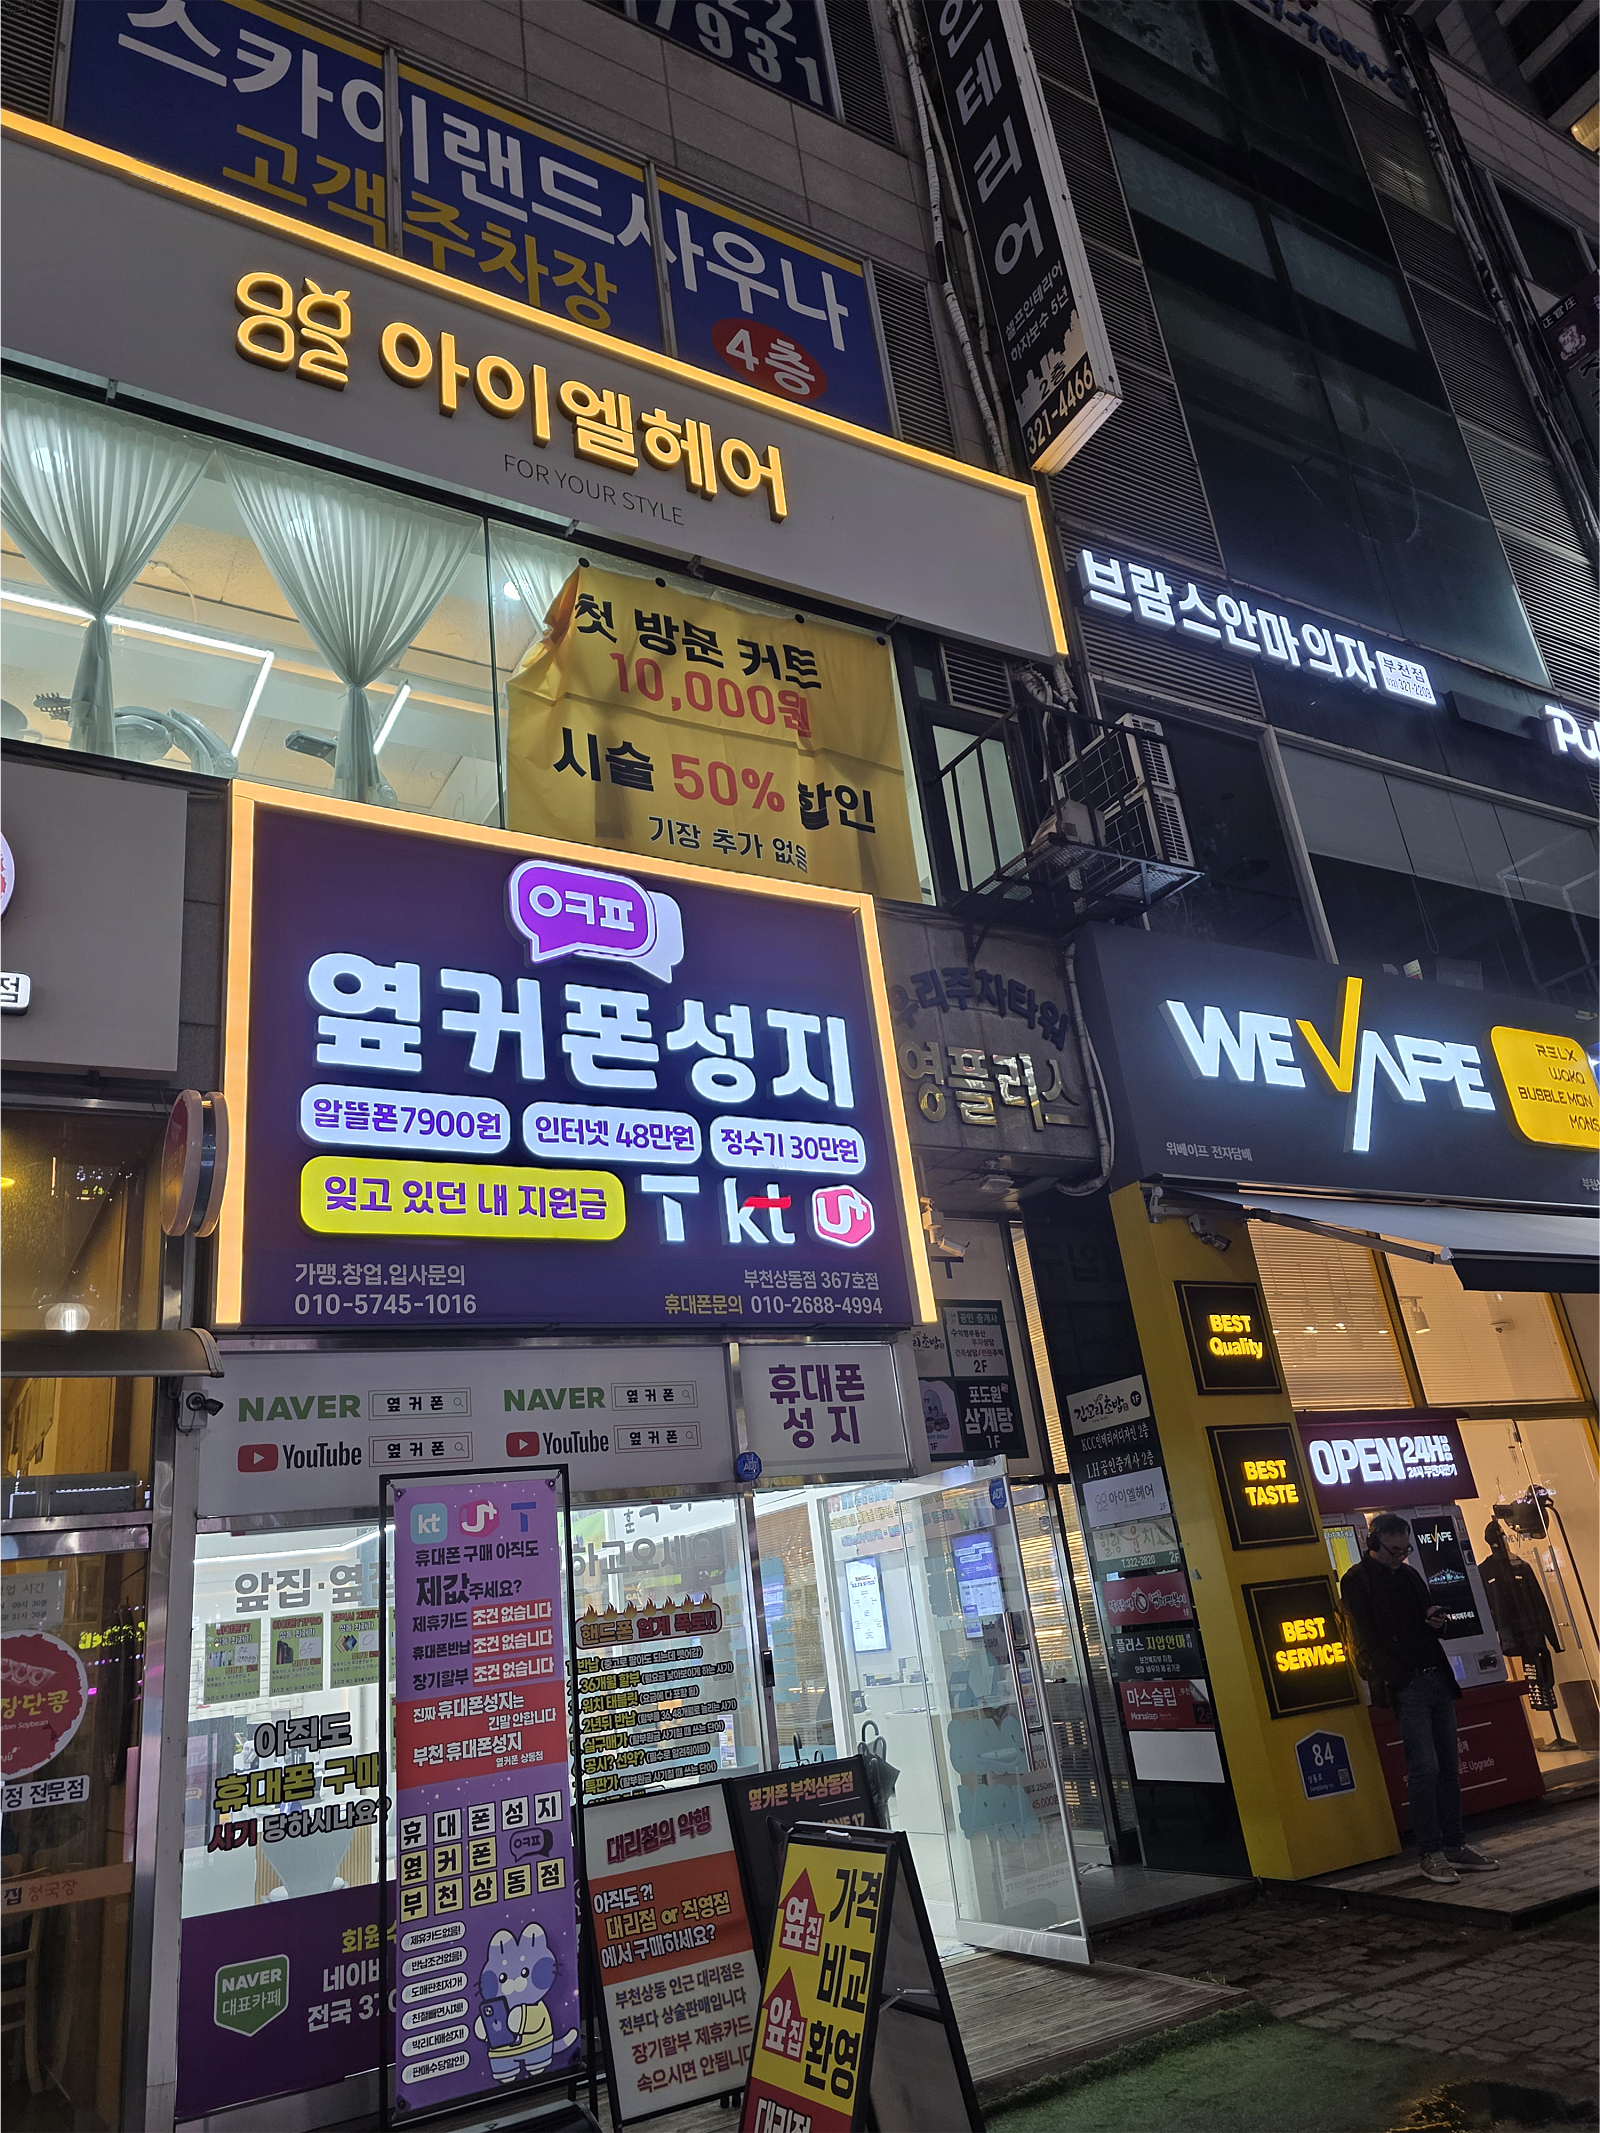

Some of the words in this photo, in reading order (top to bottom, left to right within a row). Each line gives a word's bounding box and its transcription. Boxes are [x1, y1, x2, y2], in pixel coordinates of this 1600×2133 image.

[119, 0, 850, 352] 스카이랜드사우나
[223, 124, 618, 330] 고객주차장
[1010, 312, 1050, 362] 하자보수
[1050, 285, 1070, 317] 5년
[726, 328, 817, 396] 4층
[1039, 361, 1067, 399] 2층
[379, 321, 788, 519] 아이엘헤어
[1026, 361, 1094, 455] 321-4466
[503, 453, 551, 485] FOR
[555, 466, 617, 506] YOUR
[622, 492, 686, 526] STYLE
[1081, 548, 1380, 690] 브람스안마의자
[574, 591, 618, 644] 첫
[634, 607, 726, 670] 방문
[738, 637, 823, 690] 커트
[1382, 655, 1426, 685] 부천점
[609, 652, 813, 739] 10,000원
[553, 726, 655, 793] 시술
[671, 752, 786, 813] 50%
[797, 779, 877, 834] 할인
[648, 815, 702, 850] 기장
[712, 827, 763, 860] 추가
[771, 836, 810, 875] 없음
[307, 951, 856, 1109] 옆커폰성지
[1164, 976, 1496, 1153] WEVAPE
[1534, 1043, 1579, 1063] RELX
[312, 1097, 502, 1141] 알뜰폰7900원
[535, 1115, 609, 1147] 인터넷
[614, 1111, 696, 1152] 48만원
[720, 1126, 784, 1160] 정수기
[789, 1131, 860, 1165] 30만원
[1165, 1140, 1210, 1160] 위베이프
[1212, 1145, 1253, 1163] 전자담배
[323, 1175, 392, 1214] 잊고
[402, 1178, 469, 1216] 있던
[476, 1182, 508, 1217] 내
[518, 1183, 609, 1221] 지원금
[640, 1173, 700, 1243] T
[722, 1176, 797, 1244] kt
[294, 1261, 467, 1288] 가맹.창업.입사문의
[743, 1268, 817, 1291] 부천상동점
[820, 1270, 880, 1293] 367호점
[294, 1292, 478, 1318] 010-5745-1016
[664, 1292, 744, 1316] 휴대폰문의
[749, 1294, 884, 1317] 010-2688-4994
[1208, 1314, 1252, 1333] BEST
[1209, 1336, 1263, 1359] Quality
[973, 1359, 988, 1373] 2F
[503, 1386, 606, 1411] NAVER
[768, 1362, 866, 1405] 휴대폰
[968, 1385, 1003, 1404] 포도원
[1131, 1394, 1141, 1405] 1F
[237, 1394, 361, 1422] NAVER
[964, 1407, 1015, 1435] 삼계탕
[281, 1441, 363, 1470] YouTube
[541, 1429, 610, 1455] YouTube
[742, 1460, 759, 1473] ADT
[1243, 1459, 1287, 1481] BEST
[1308, 1437, 1407, 1485] OPEN
[1108, 1483, 1155, 1506] 아이엘헤어
[1244, 1483, 1300, 1507] TASTE
[417, 1512, 441, 1535] kt
[510, 1501, 537, 1533] T
[415, 1546, 461, 1567] 휴대폰
[463, 1543, 493, 1563] 구매
[495, 1539, 540, 1560] 아직도
[1168, 1550, 1180, 1564] 2F
[412, 1611, 469, 1633] 제휴카드
[472, 1607, 499, 1627] 조건
[501, 1601, 553, 1623] 없습니다
[580, 1619, 634, 1646] 핸드폰
[636, 1615, 671, 1639] 업계
[674, 1610, 717, 1634] 폭로!!
[1280, 1616, 1326, 1643] BEST
[412, 1640, 471, 1661] 휴대폰반납
[473, 1635, 500, 1655] 조건
[501, 1629, 554, 1651] 없습니다
[1115, 1637, 1145, 1653] 플러스
[1145, 1634, 1186, 1651] 지압안마
[1275, 1641, 1347, 1673] SERVICE
[412, 1667, 469, 1692] 장기할부
[473, 1663, 500, 1683] 조건
[502, 1656, 555, 1679] 없습니다
[576, 1657, 600, 1674] 반납
[580, 1674, 617, 1695] 36개월
[618, 1671, 641, 1688] 할부
[1126, 1686, 1178, 1708] 마스슬립
[412, 1705, 437, 1724] 진짜
[437, 1690, 525, 1720] 휴대폰성지는
[605, 1691, 639, 1709] 태블릿
[253, 1710, 352, 1758] 아직도
[488, 1712, 513, 1733] 긴말
[512, 1706, 558, 1729] 안합니다
[582, 1715, 614, 1733] 2년뒤
[614, 1711, 637, 1727] 반납
[412, 1742, 445, 1767] 부천
[445, 1731, 523, 1762] 휴대폰성지
[494, 1753, 520, 1768] 옆커폰
[519, 1750, 544, 1765] 상동점
[583, 1733, 629, 1754] 실구매가
[1311, 1741, 1335, 1768] 84
[584, 1755, 614, 1775] 공시?
[615, 1750, 645, 1768] 선약?
[1468, 1756, 1496, 1773] Upgrade
[29, 1777, 86, 1806] 전문점
[213, 1763, 316, 1815] 휴대폰
[583, 1775, 619, 1795] 특판가
[748, 1782, 789, 1812] 옆커폰
[790, 1771, 854, 1803] 부천상동점
[207, 1817, 258, 1853] 사기
[262, 1796, 392, 1844] 당하시나요?
[606, 1817, 677, 1865] 대리점의
[676, 1805, 713, 1839] 악행
[27, 1878, 78, 1903] 청국장
[828, 1867, 883, 1934] 가격
[605, 1907, 658, 1941] 대리점
[660, 1906, 678, 1926] or
[681, 1891, 732, 1923] 직영점
[783, 1896, 823, 1953] 옆집
[221, 1967, 282, 1994] NAVER
[614, 1980, 668, 2011] 부천상동
[668, 1973, 696, 1996] 인근
[696, 1961, 745, 1988] 대리점은
[816, 1942, 874, 2014] 비교
[221, 1987, 282, 2017] 대표카페
[307, 1997, 352, 2033] 전국
[618, 2008, 660, 2037] 전부다
[661, 1986, 747, 2025] 상술판매입니다
[631, 2030, 693, 2066] 장기할부
[694, 2014, 754, 2047] 제휴카드
[764, 1996, 805, 2060] 앞집
[803, 2019, 862, 2100] 환영
[636, 2059, 698, 2094] 속으시면
